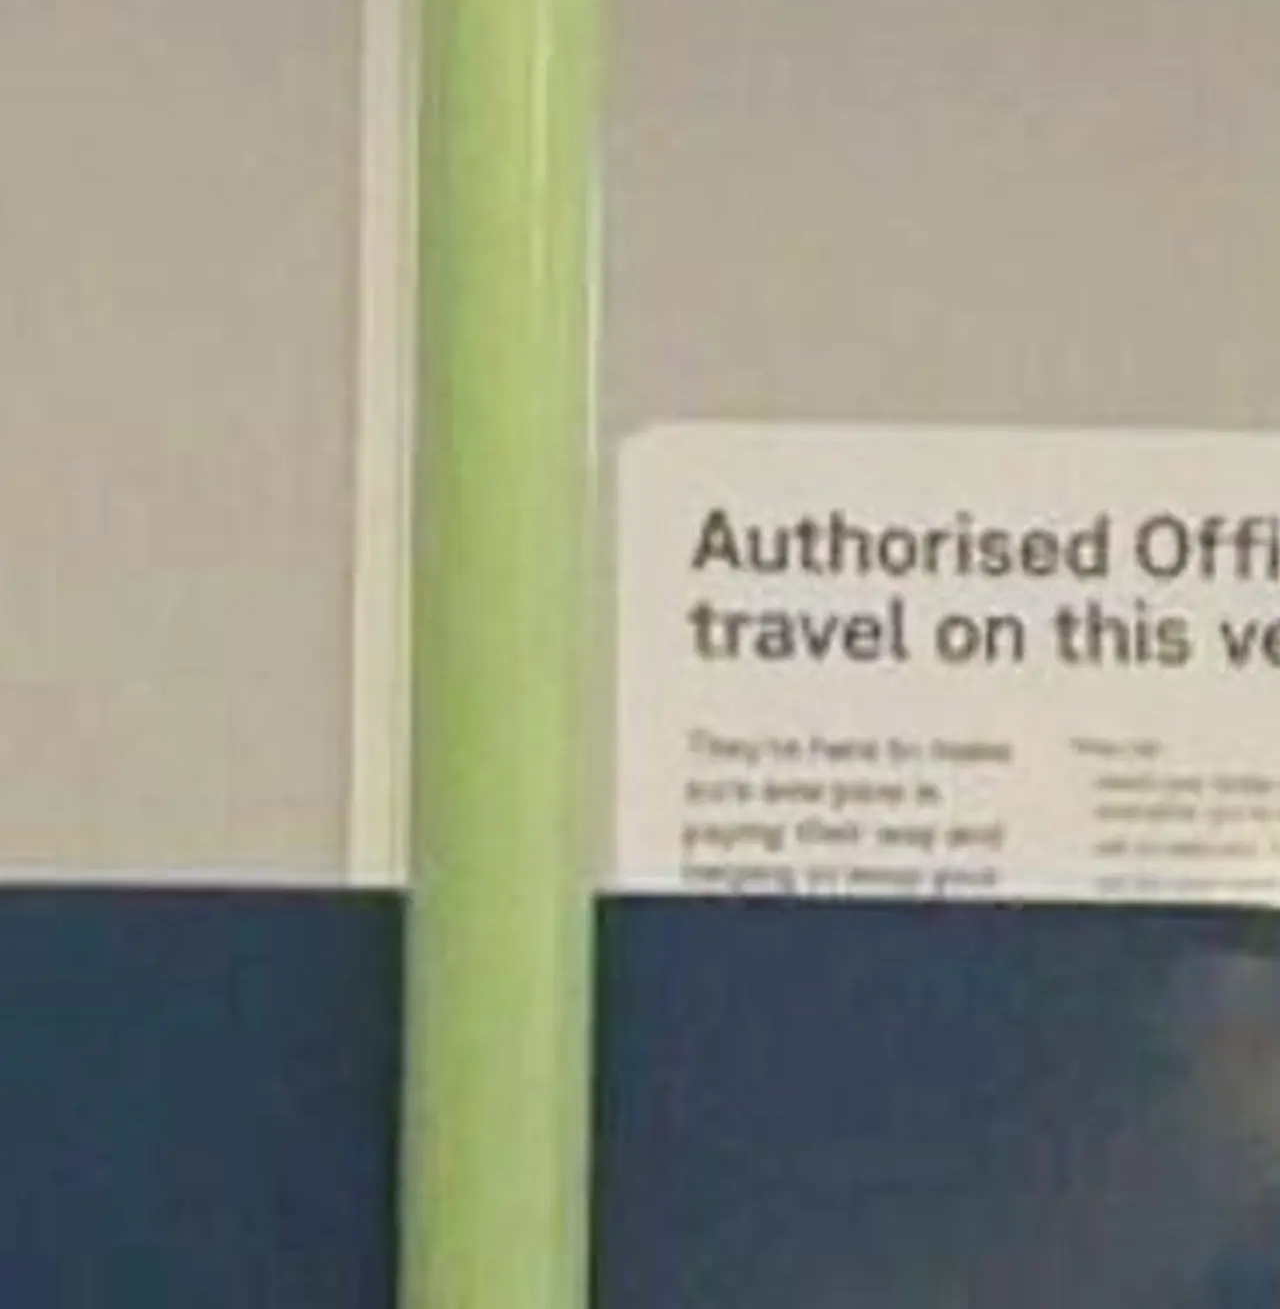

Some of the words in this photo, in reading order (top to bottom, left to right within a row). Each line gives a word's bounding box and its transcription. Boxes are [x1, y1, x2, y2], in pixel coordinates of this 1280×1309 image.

[691, 509, 1112, 578] Authorised
[687, 599, 910, 663] travel
[934, 613, 1026, 666] on
[1054, 601, 1194, 669] this
